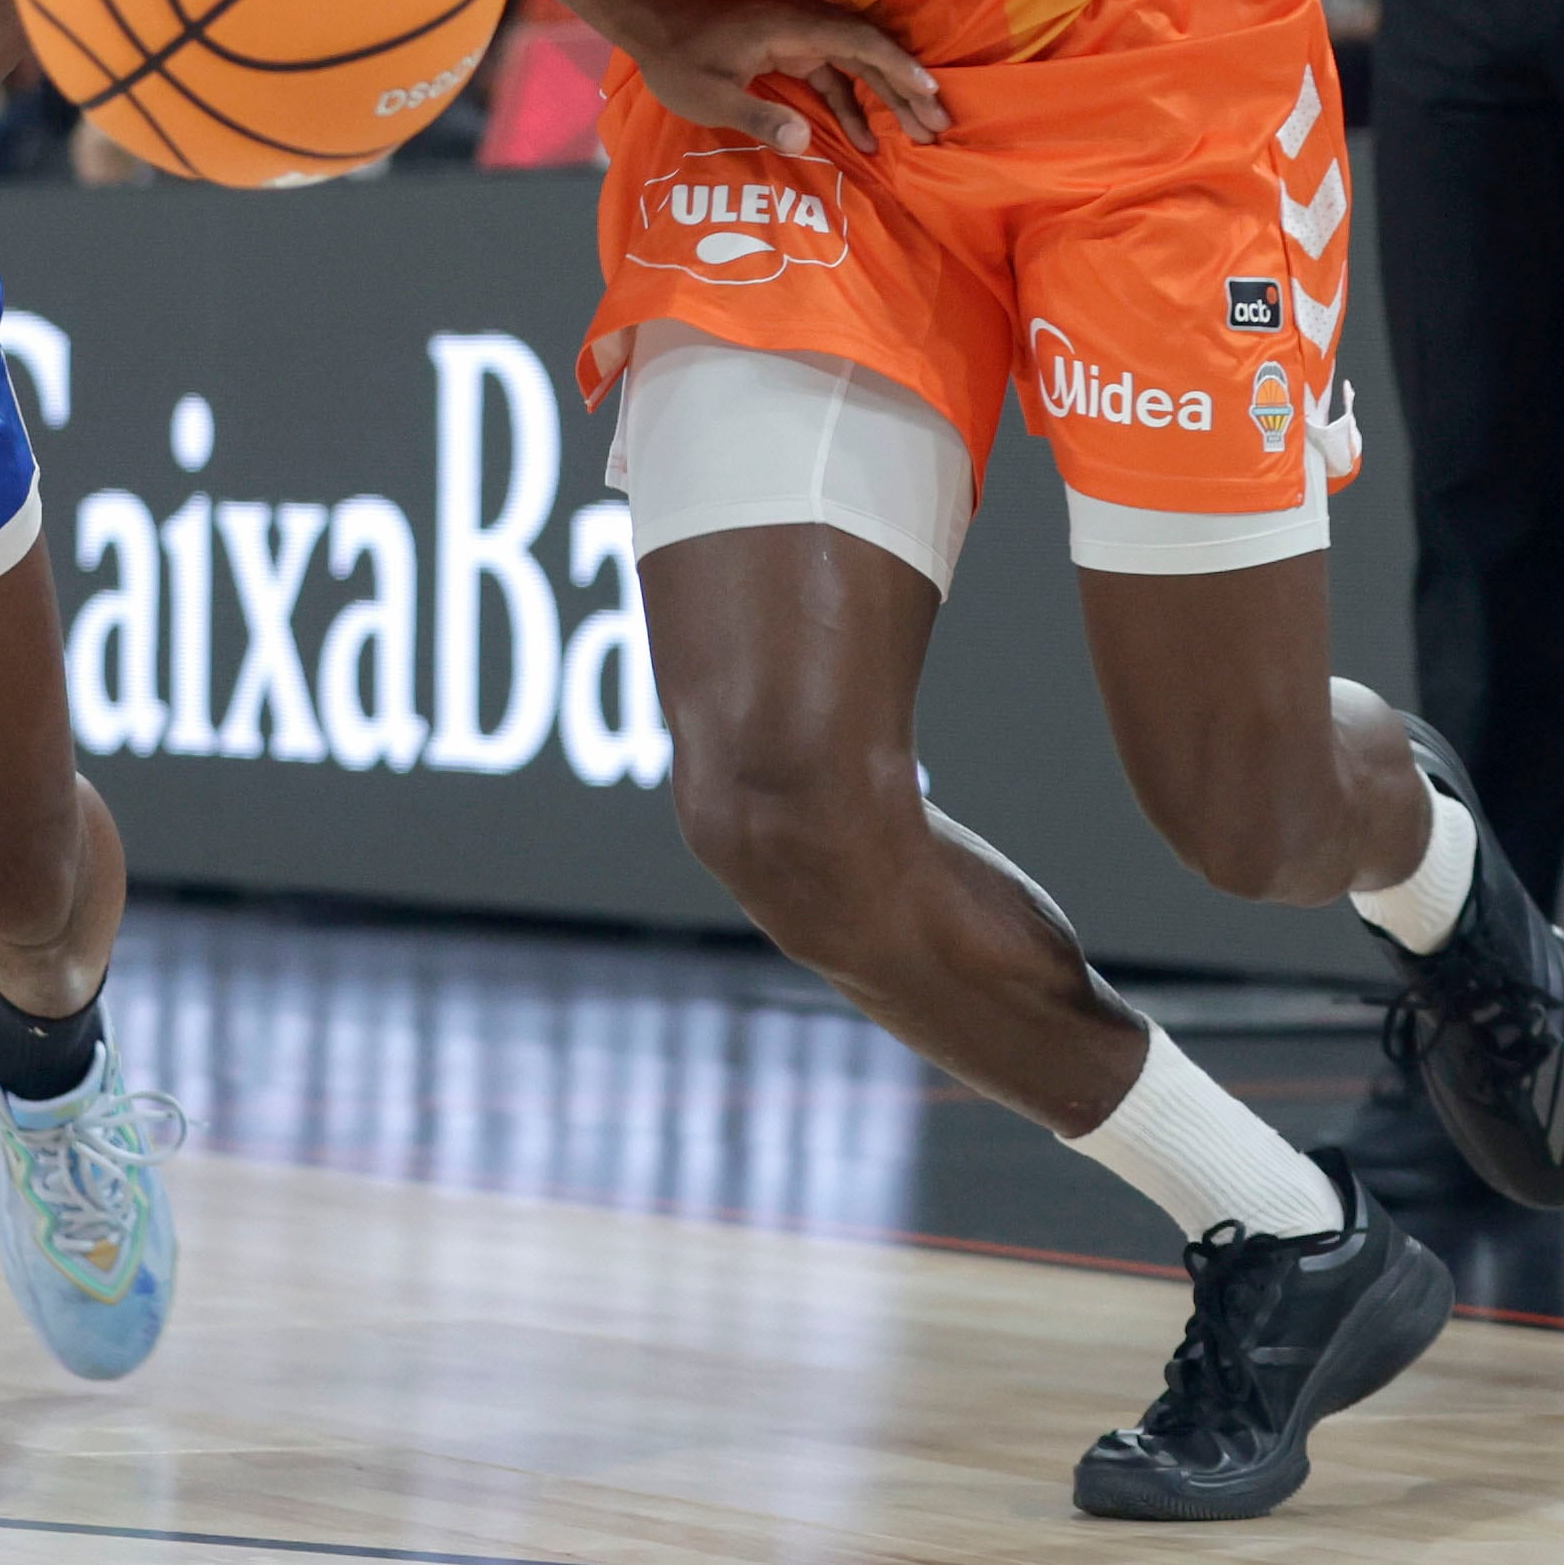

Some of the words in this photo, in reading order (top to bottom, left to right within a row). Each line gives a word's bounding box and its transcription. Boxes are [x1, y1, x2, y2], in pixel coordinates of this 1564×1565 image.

[657, 183, 831, 234] ULEVA
[1235, 298, 1272, 324] acb
[1038, 354, 1213, 431] Midea
